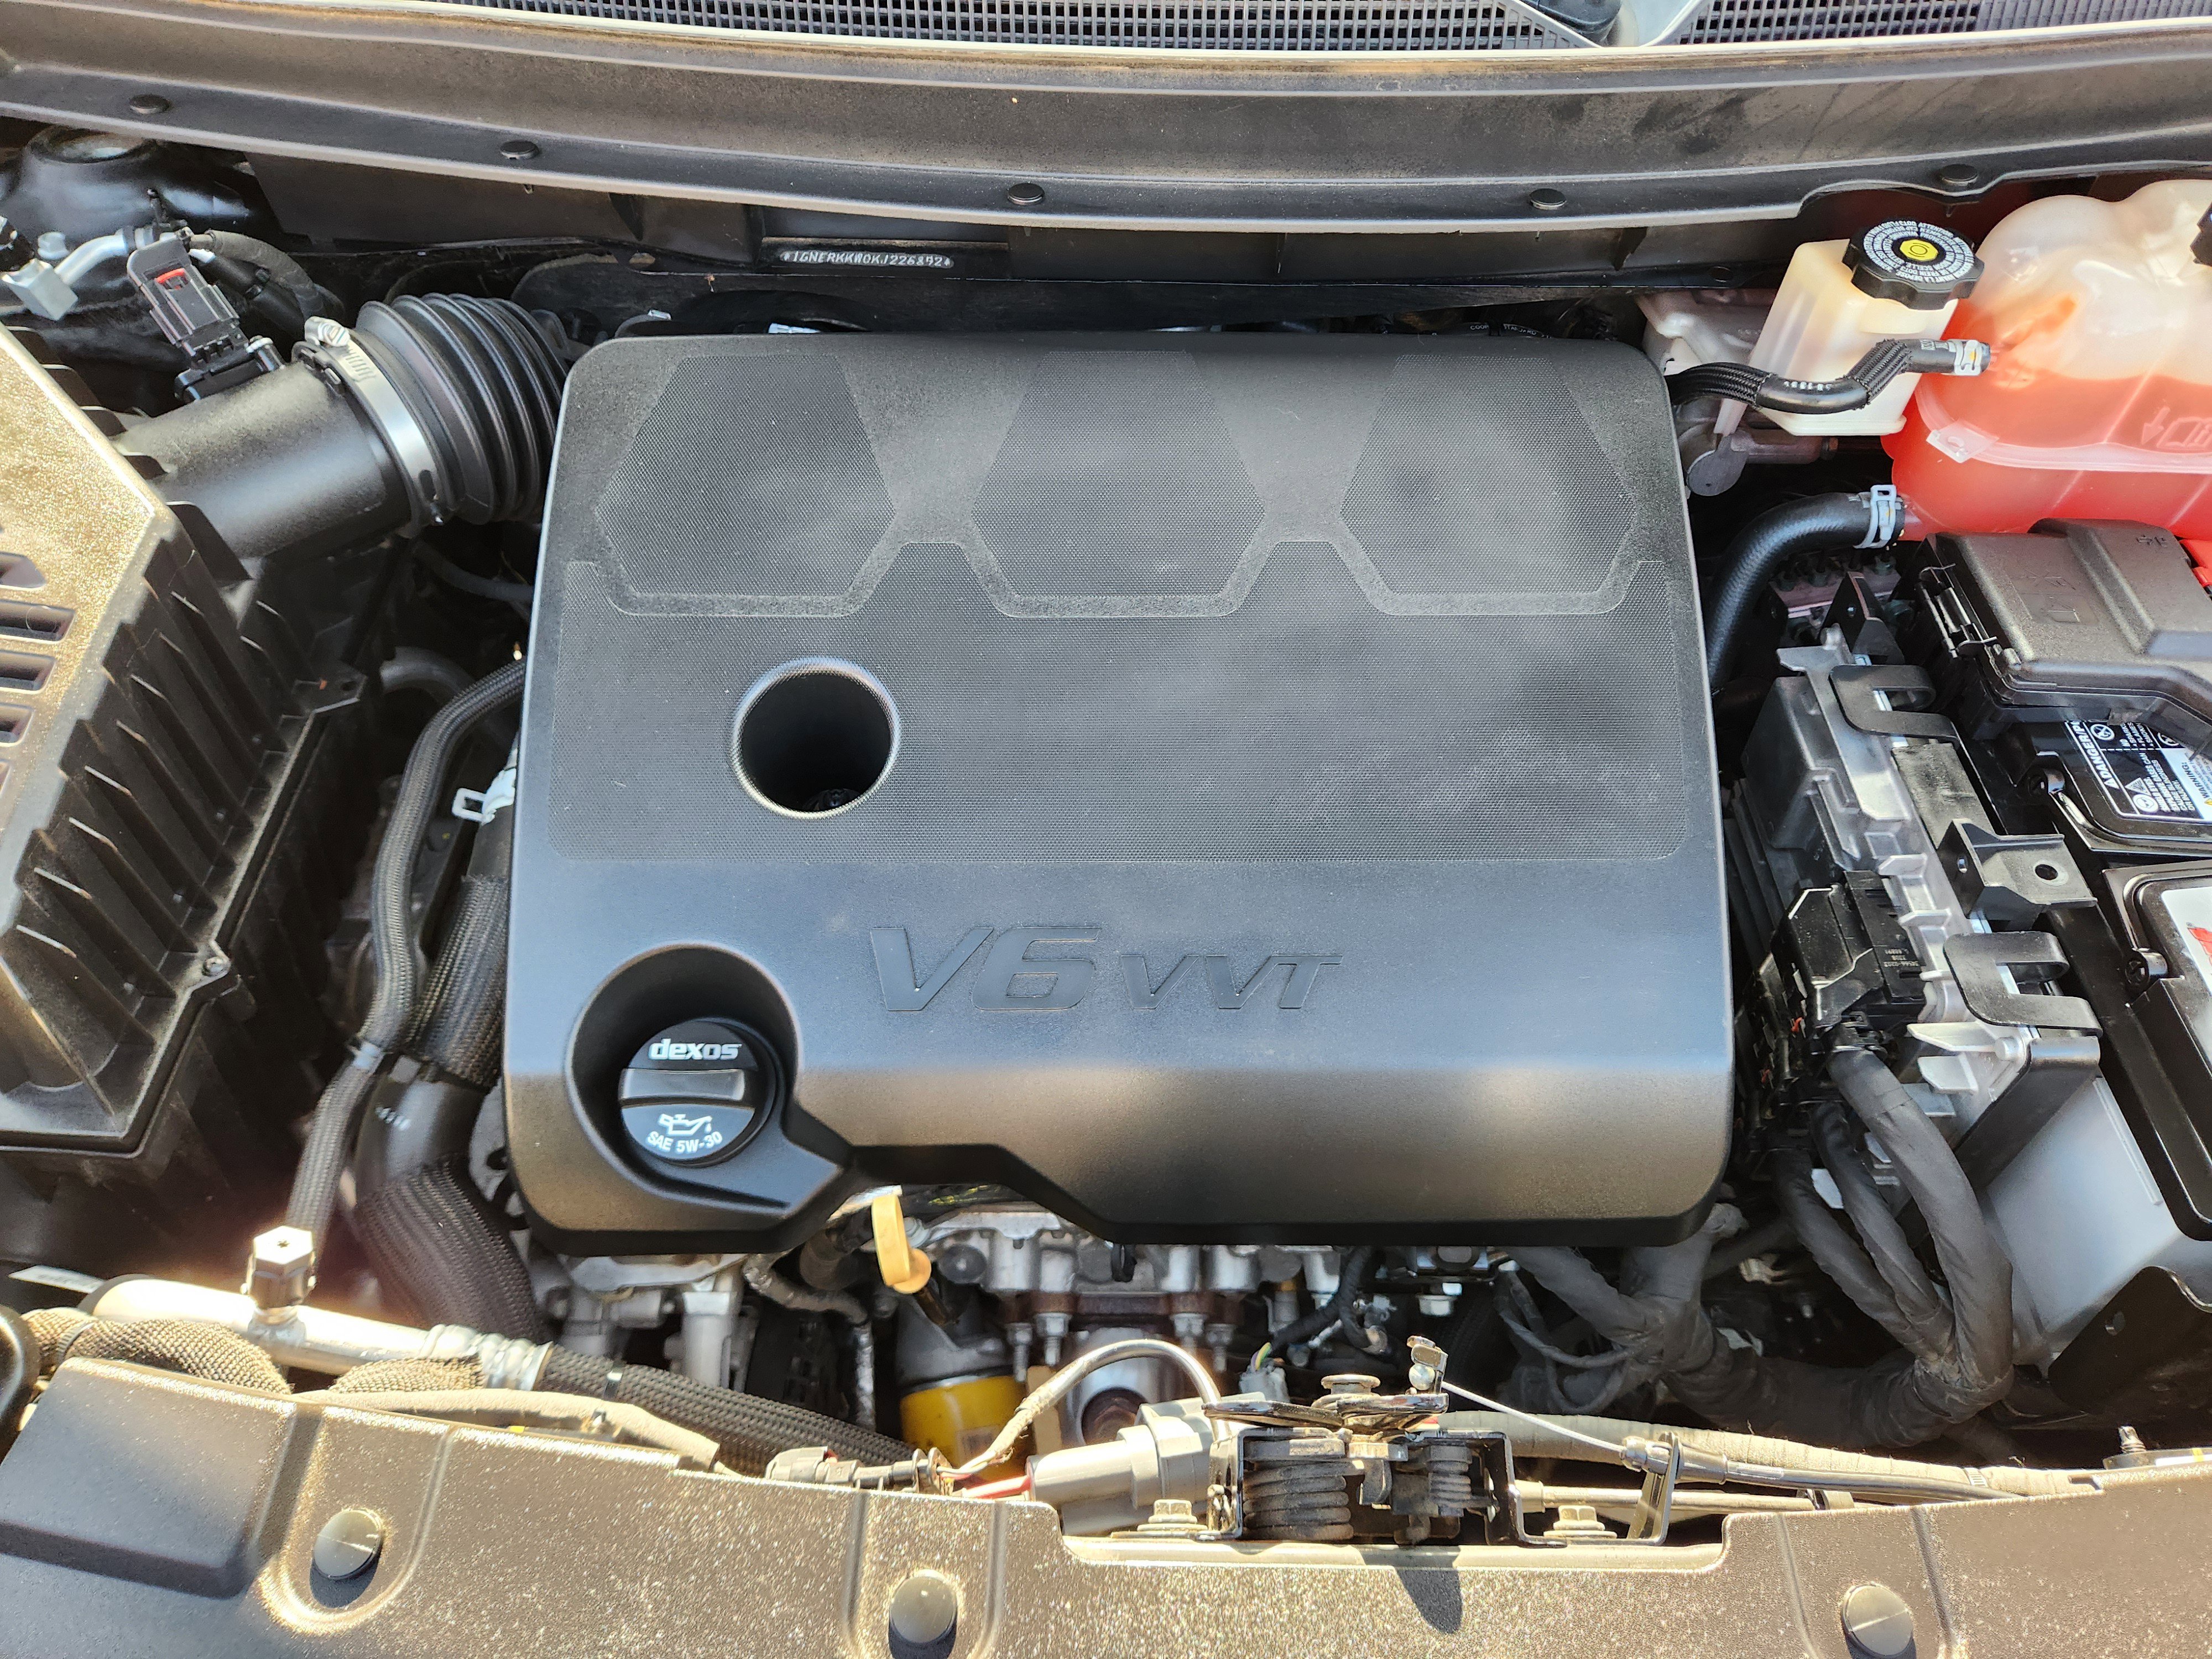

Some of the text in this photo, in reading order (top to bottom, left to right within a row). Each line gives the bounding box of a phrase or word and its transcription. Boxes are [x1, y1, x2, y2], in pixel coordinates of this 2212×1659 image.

[1869, 225, 1885, 235] FROM
[1882, 226, 1906, 235] BEFORE
[1883, 238, 1893, 251] CLEAN
[1920, 232, 1953, 252] PROVENANT
[1876, 251, 1888, 259] USE
[1884, 258, 1900, 268] ONLY
[1885, 251, 1905, 264] FILLER
[2127, 722, 2145, 743] FLAMES
[2139, 753, 2180, 811] EXPLOSIVE GASES CAN
[2151, 760, 2188, 811] CAUSE BLINDNESS
[2181, 762, 2210, 799] WARNING:
[2152, 792, 2171, 811] SHIELD
[2184, 801, 2195, 811] OR
[870, 926, 1343, 1011] V6 VVT
[649, 1037, 741, 1061] dexos
[646, 1130, 723, 1154] SAE 5W-30
